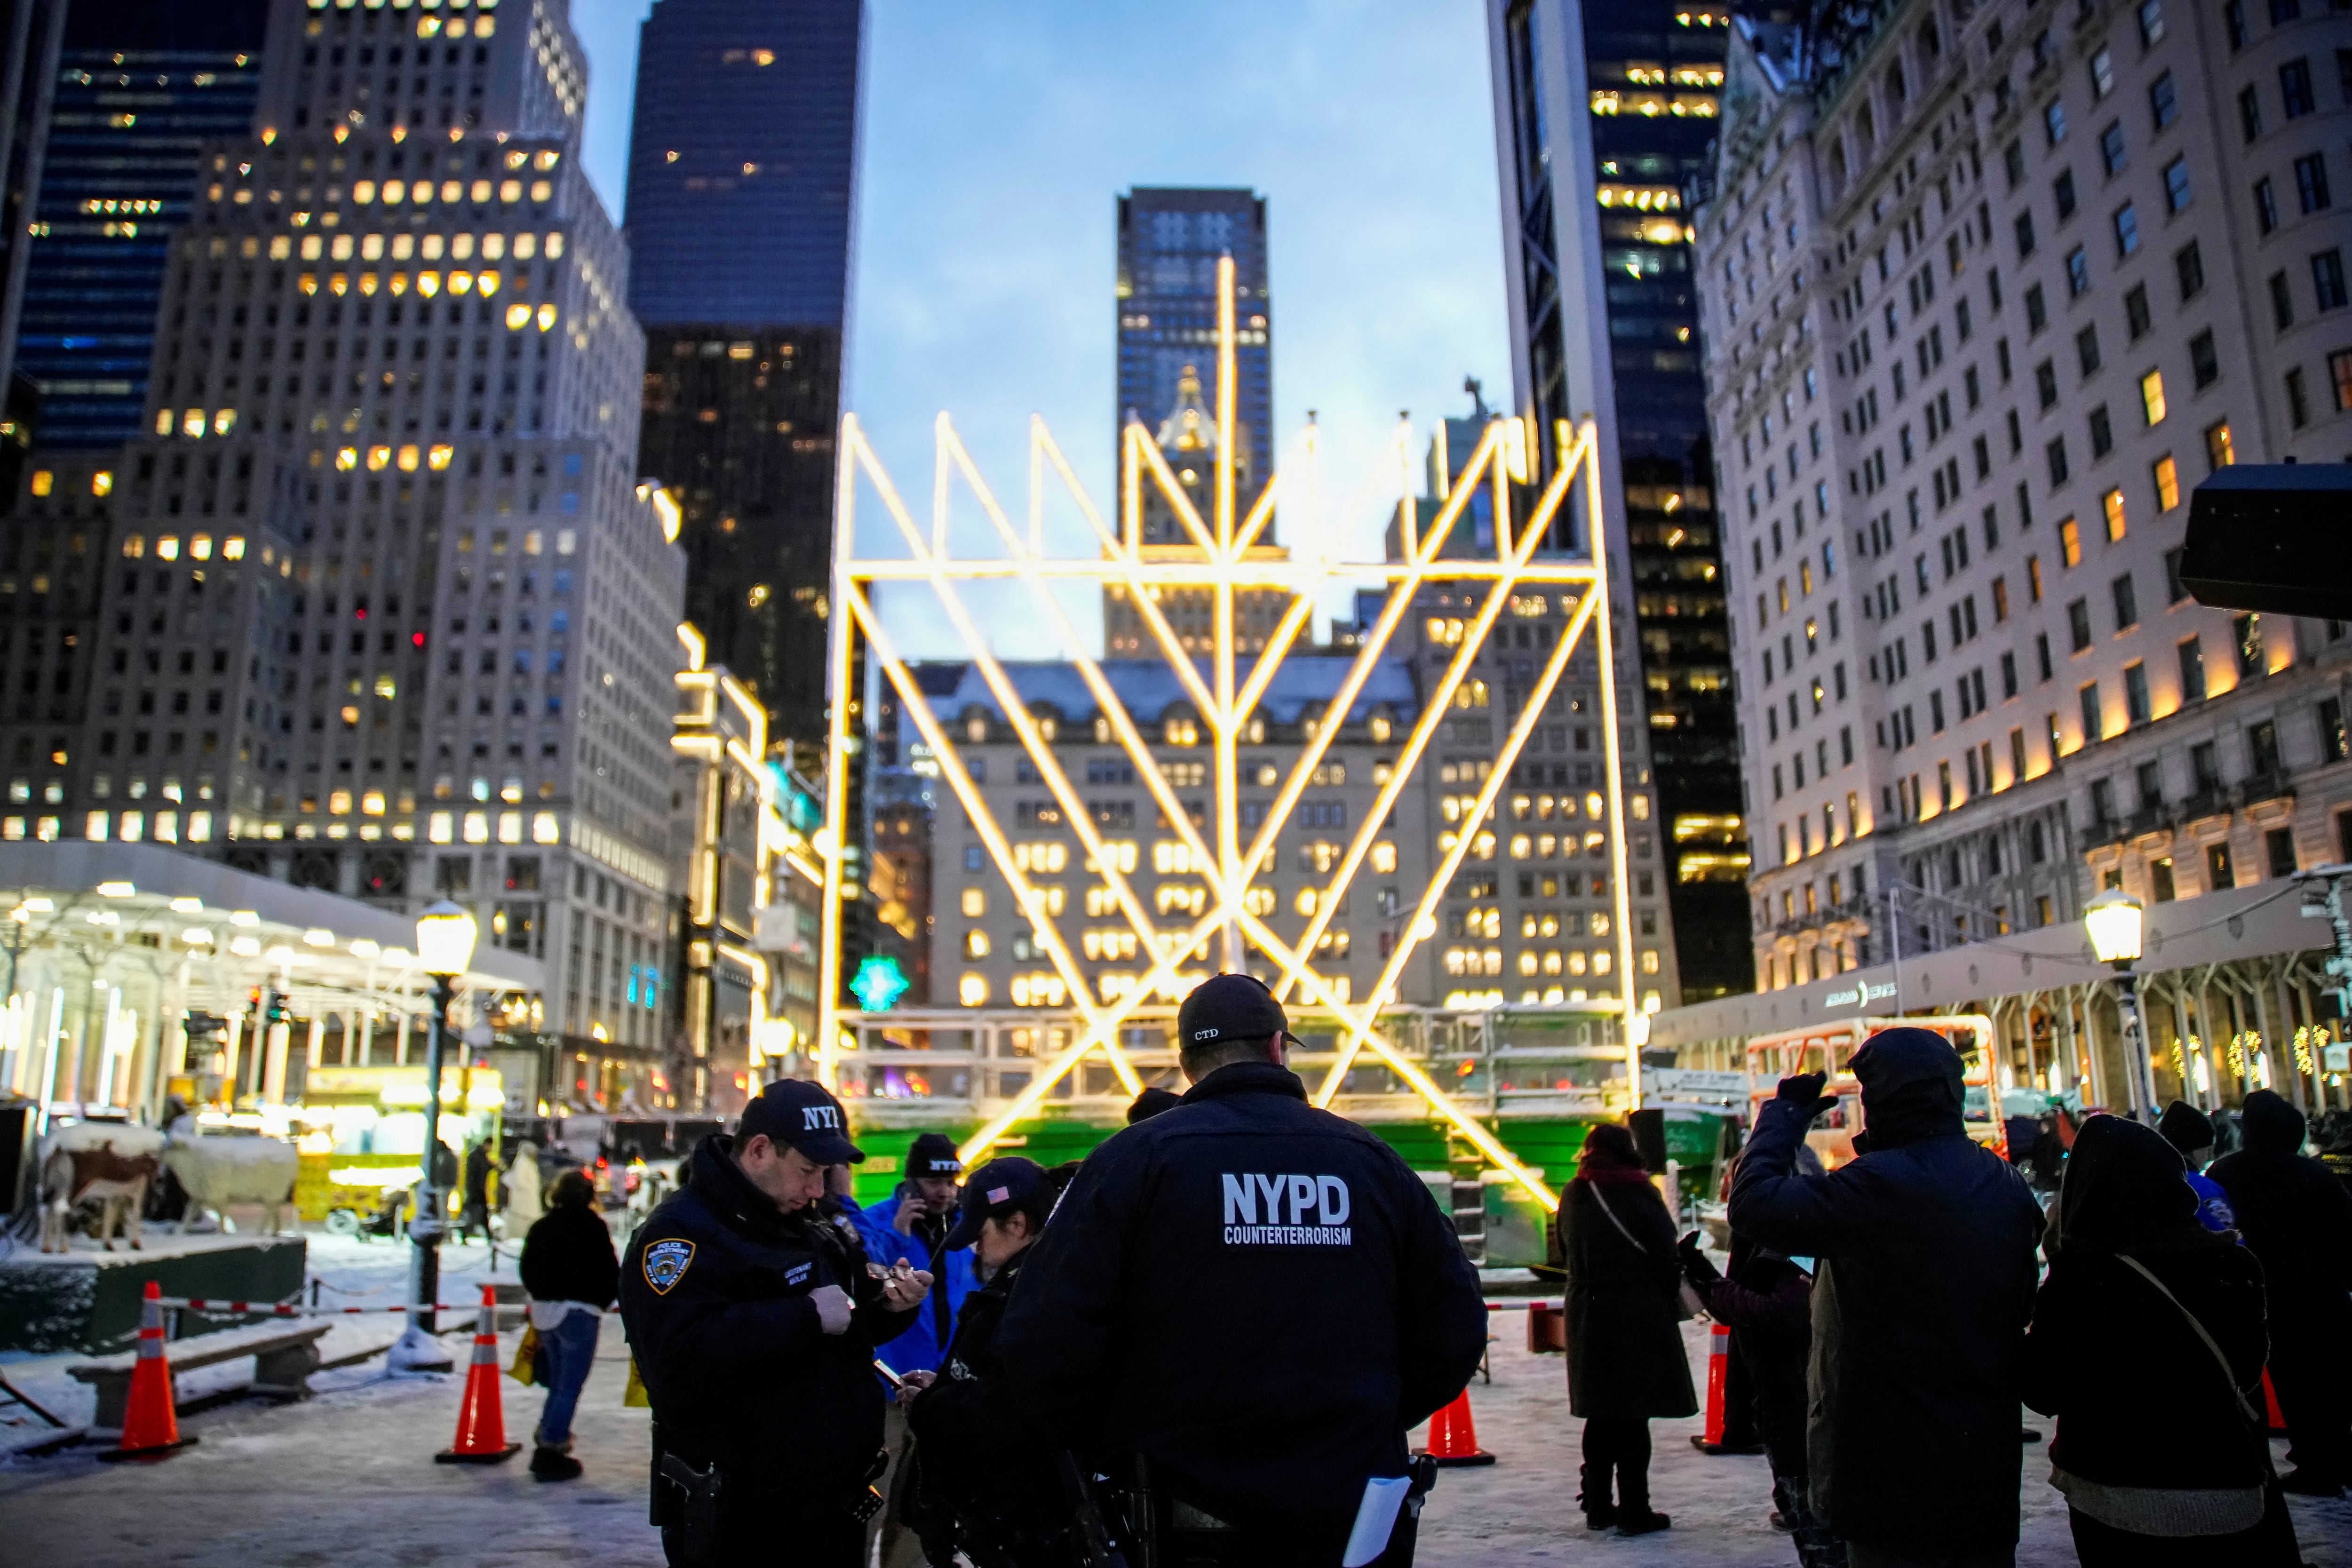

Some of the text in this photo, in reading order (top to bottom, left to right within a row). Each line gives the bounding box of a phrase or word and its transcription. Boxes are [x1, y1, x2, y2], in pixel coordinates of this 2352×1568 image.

[1195, 1028, 1218, 1040] CTD
[1222, 1174, 1350, 1225] NYPD
[1224, 1226, 1351, 1245] COUNTERTERRORISM
